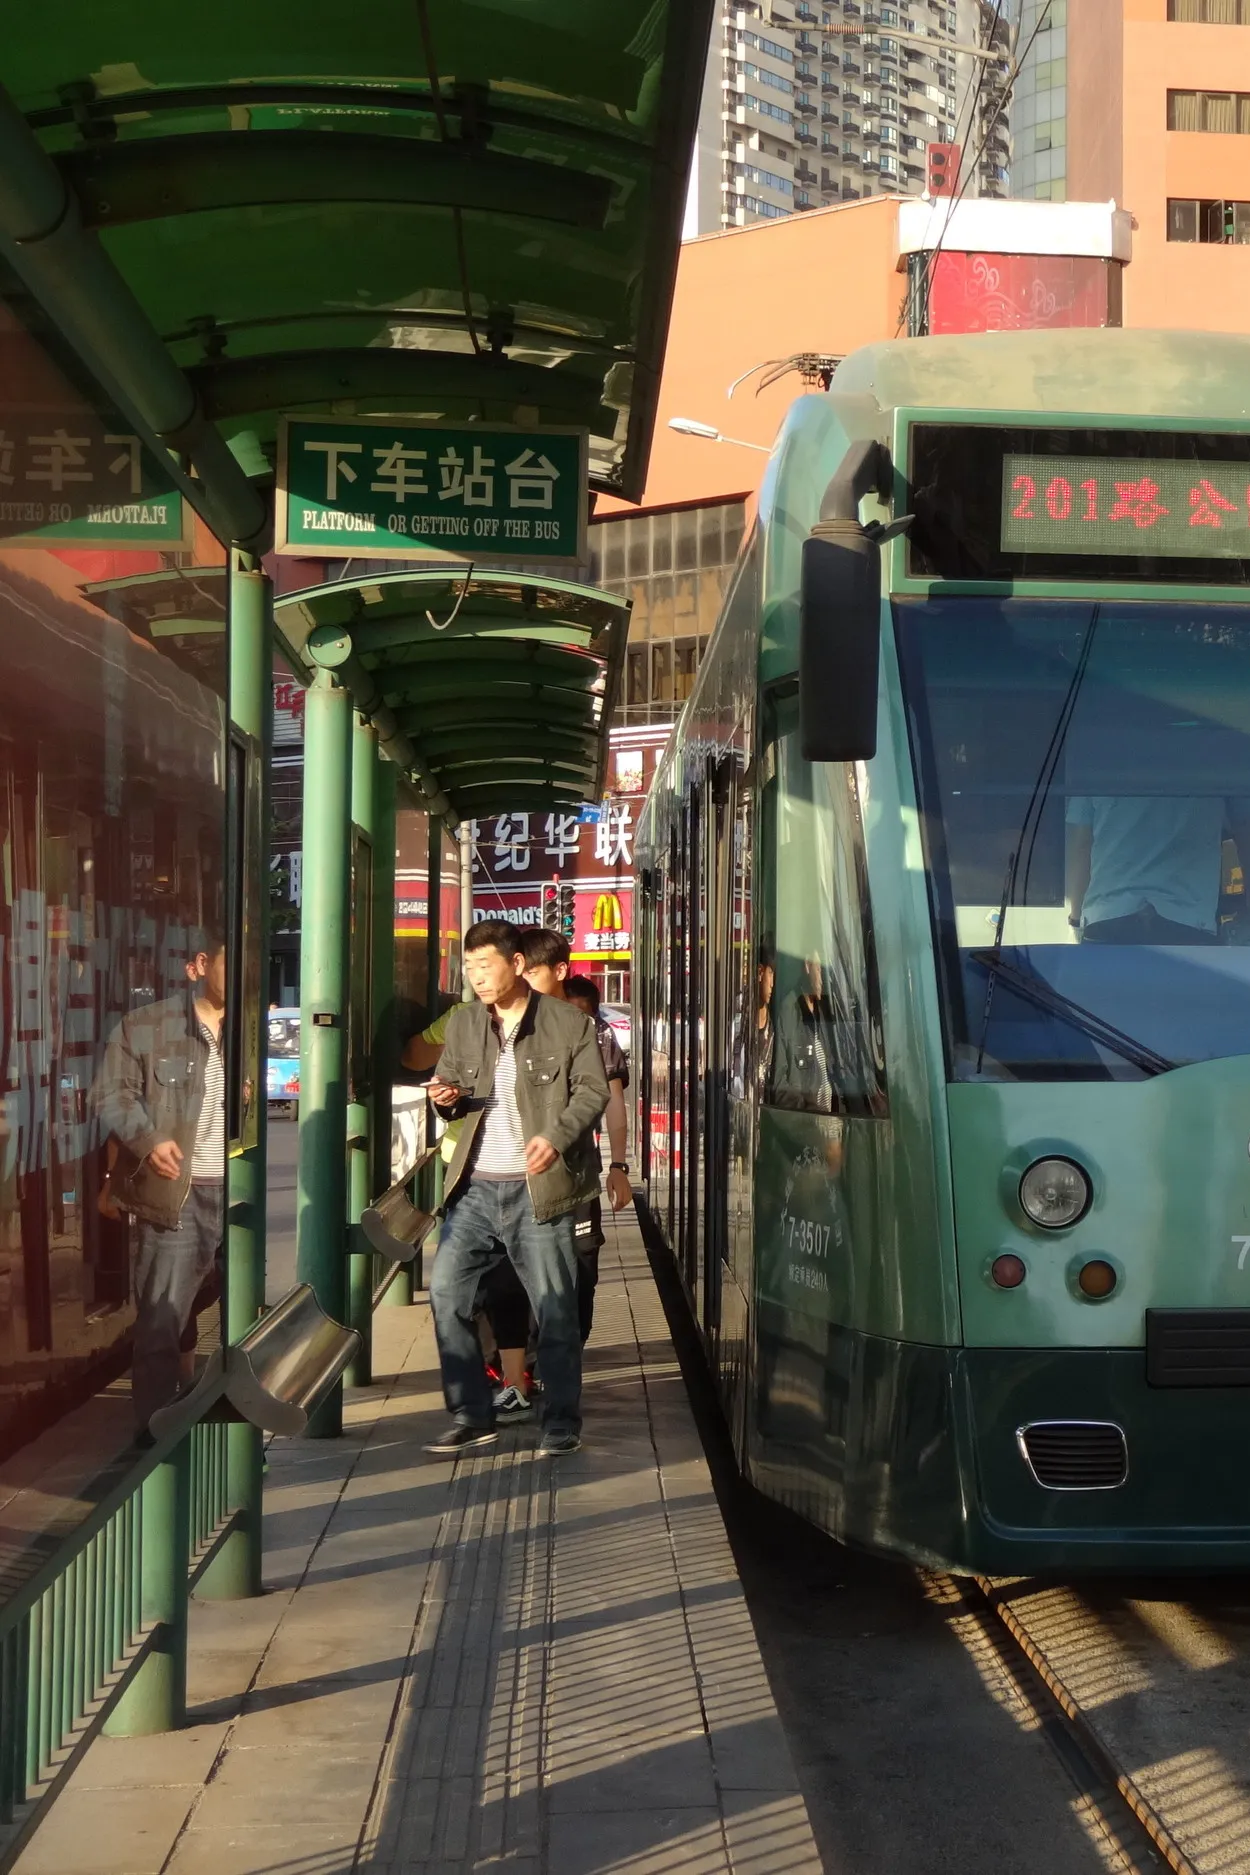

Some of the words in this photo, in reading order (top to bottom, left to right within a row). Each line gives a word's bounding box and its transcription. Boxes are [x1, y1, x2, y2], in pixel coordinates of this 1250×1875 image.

[304, 441, 561, 510] 下车站台
[1011, 475, 1169, 528] 201路
[303, 509, 376, 532] PLATFORM
[388, 514, 407, 533] OR
[411, 516, 470, 536] GETTING
[474, 518, 499, 537] OFF
[504, 519, 530, 538] THE
[535, 520, 560, 540] BUS
[584, 932, 631, 951] 麦当劳
[789, 1216, 831, 1258] 7-3507
